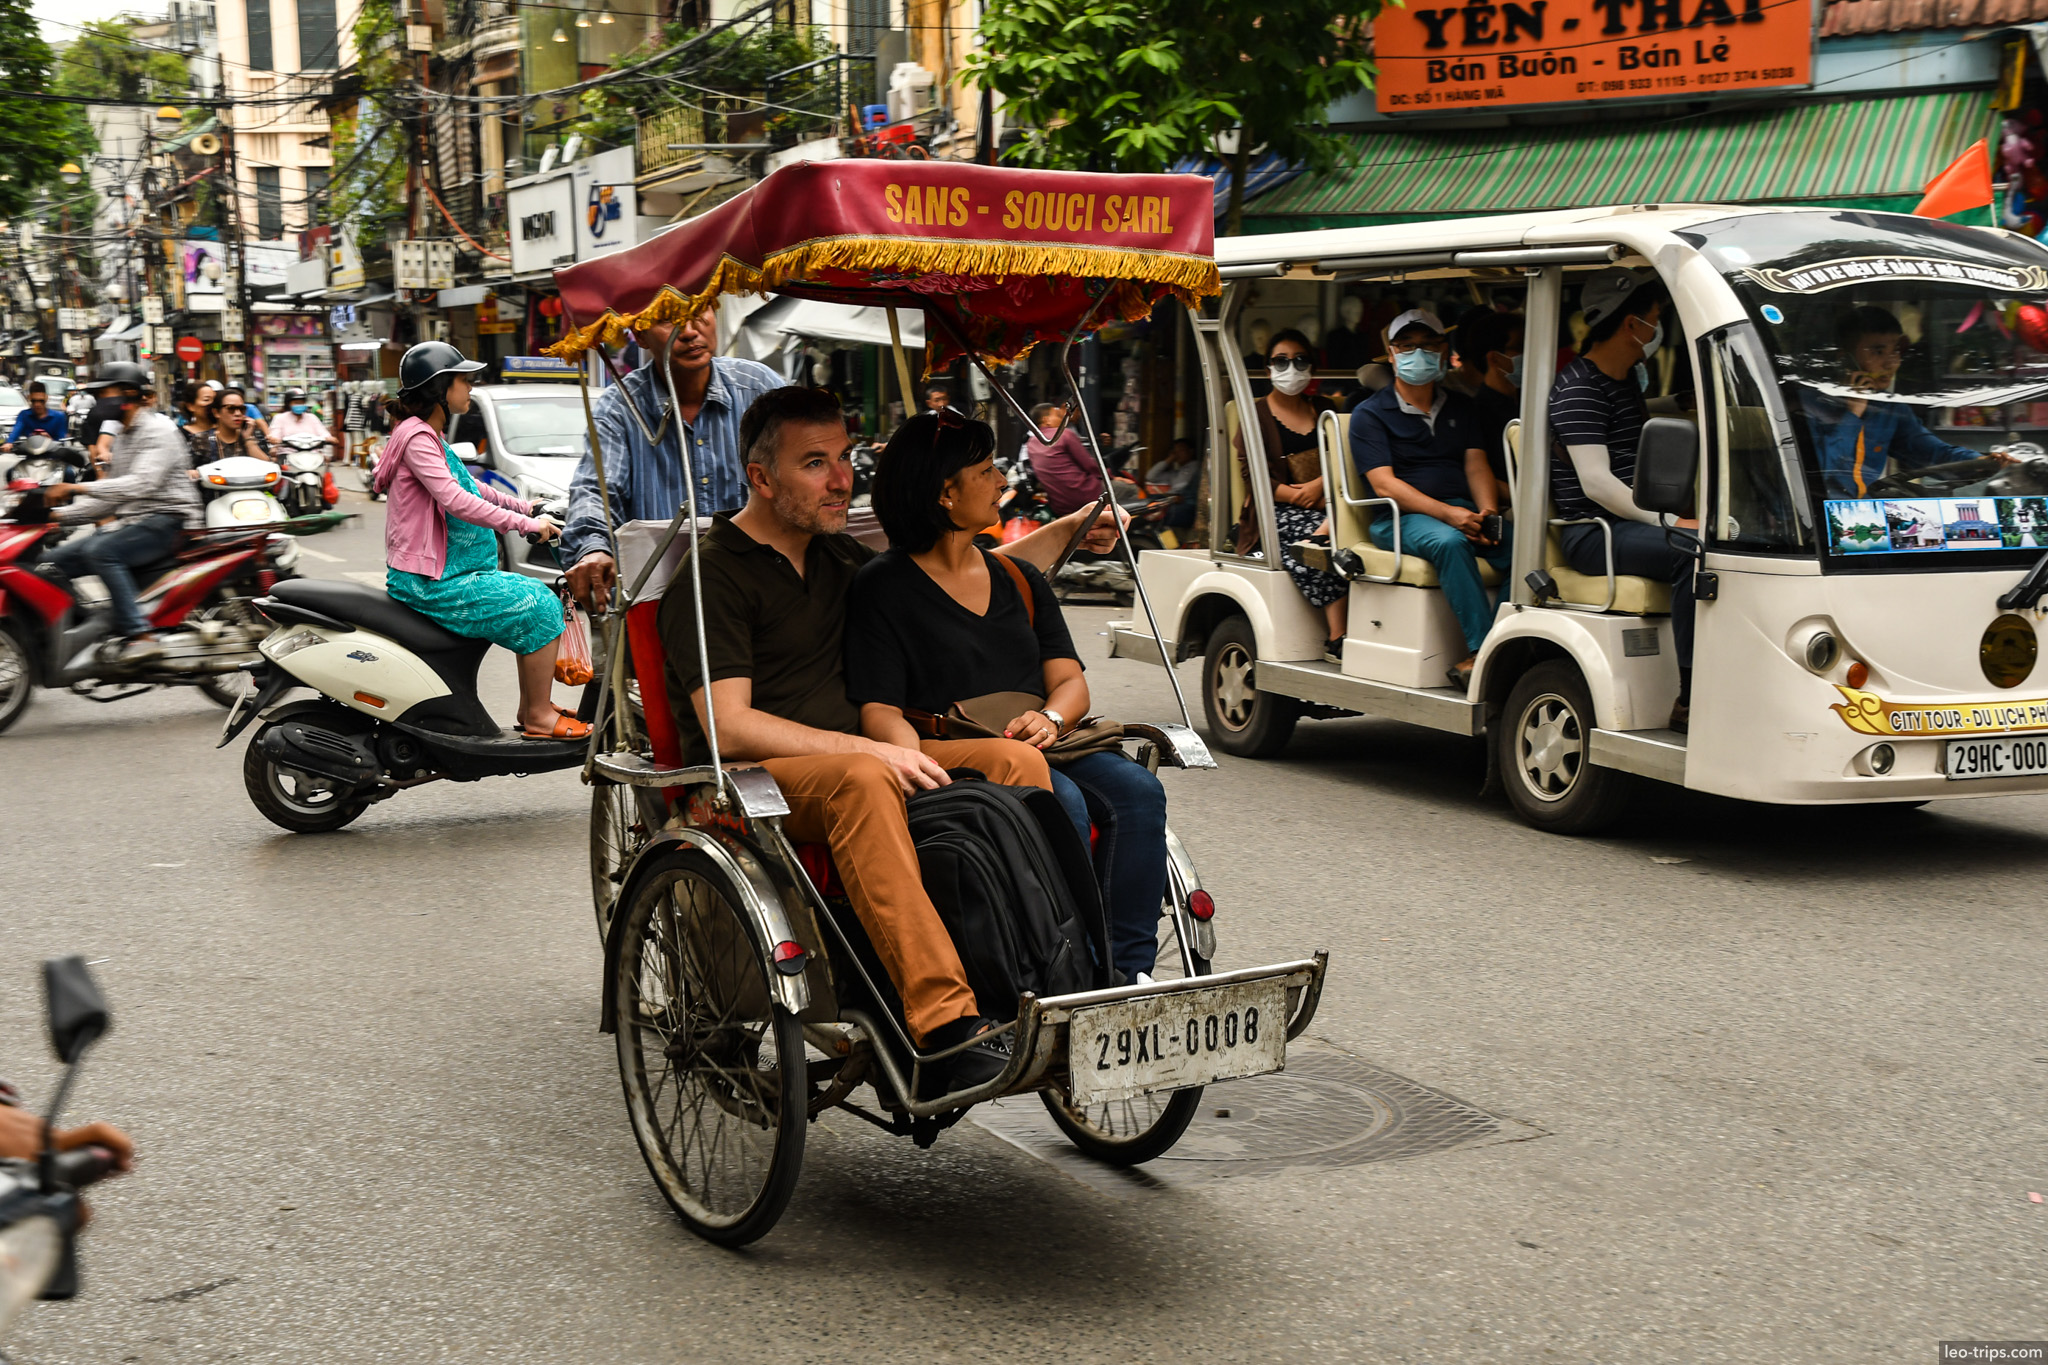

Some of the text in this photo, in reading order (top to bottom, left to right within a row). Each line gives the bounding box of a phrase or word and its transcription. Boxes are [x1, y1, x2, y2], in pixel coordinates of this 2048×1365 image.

[1414, 0, 1547, 48] YÊN
[1427, 57, 1485, 83] Bán
[1498, 52, 1577, 79] Buôn
[1618, 43, 1680, 70] Bán
[1695, 36, 1730, 64] Lẻ
[885, 184, 1174, 234] SANS - SOUCI SARL
[1823, 266, 1846, 280] XE
[1891, 711, 1921, 731] CITY
[1925, 710, 1963, 729] TOUR
[1973, 709, 1992, 727] DU
[1994, 706, 2028, 731] LỊCH
[2028, 702, 2048, 724] PH
[1955, 742, 2047, 774] 29HC-000
[1096, 1006, 1259, 1071] 29XL-0008
